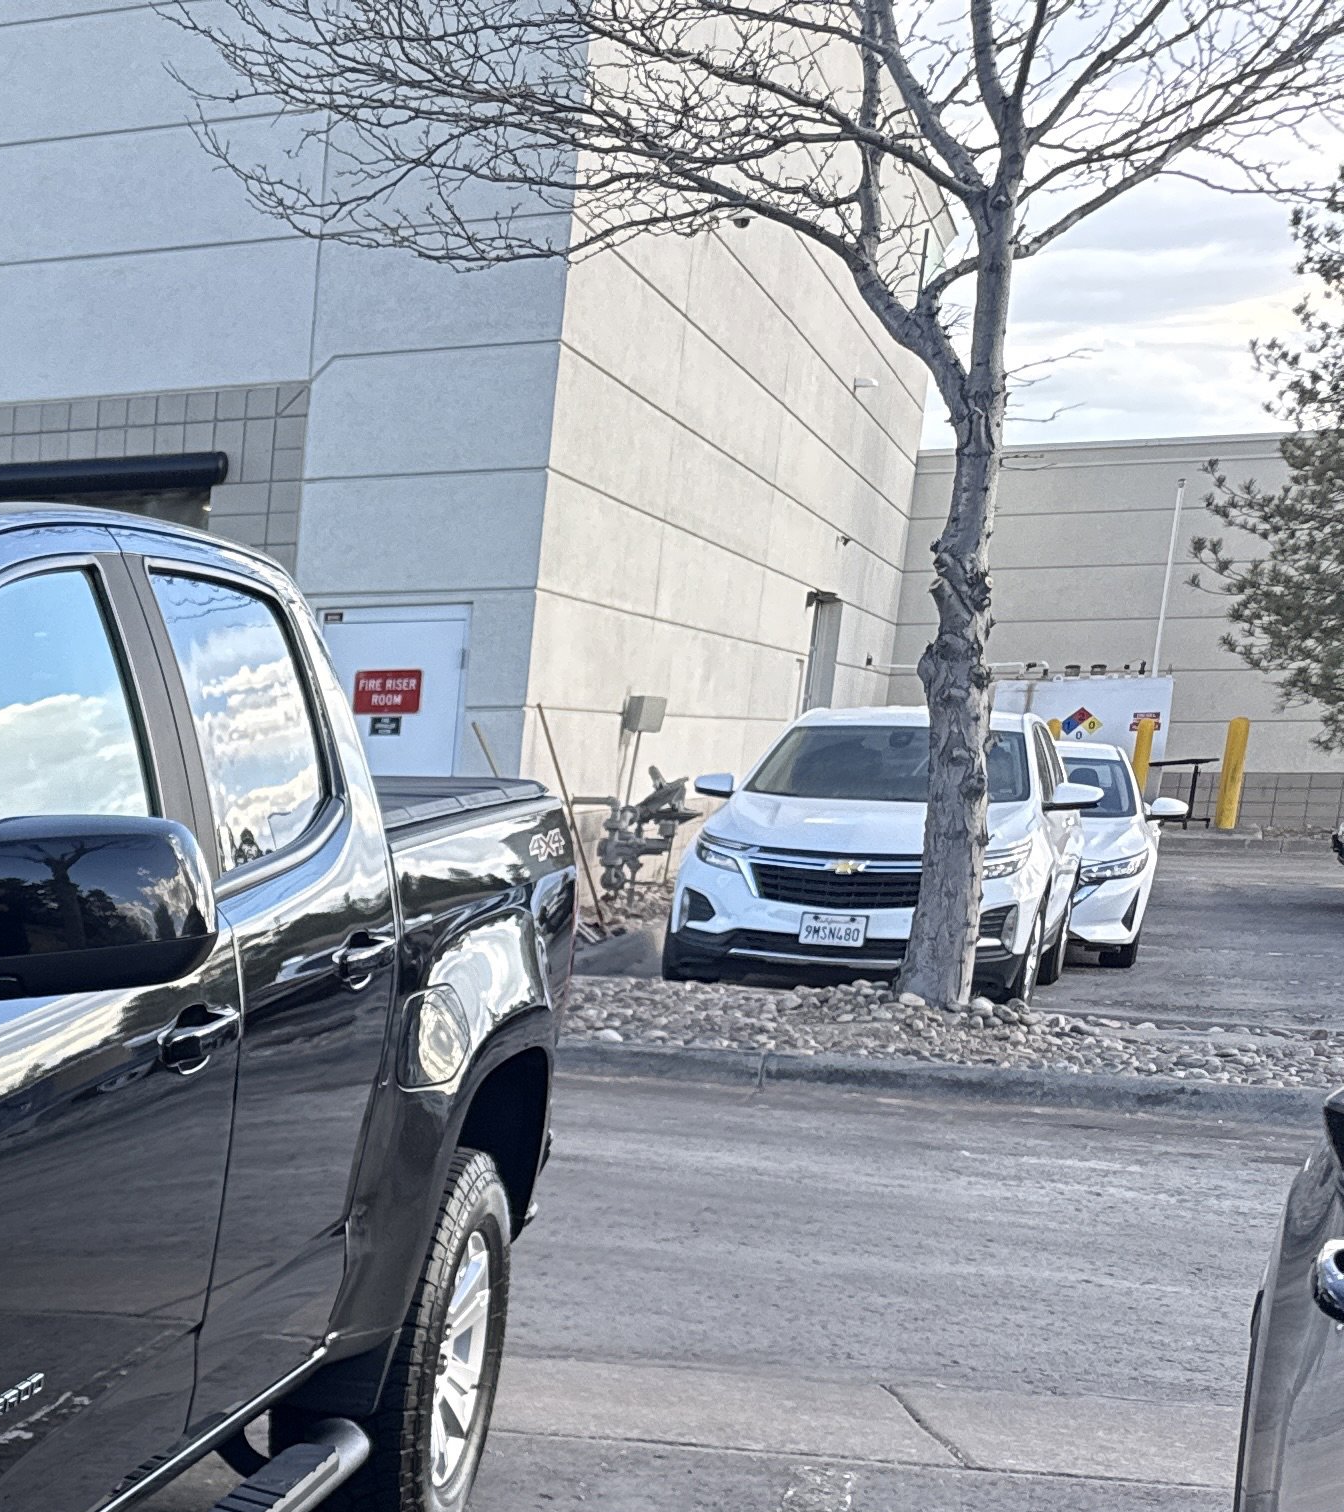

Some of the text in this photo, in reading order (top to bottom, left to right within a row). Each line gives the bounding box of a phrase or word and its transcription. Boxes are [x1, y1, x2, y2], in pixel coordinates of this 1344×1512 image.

[358, 679, 417, 691] FIRE RISER
[371, 694, 402, 705] ROOM
[1078, 712, 1086, 721] 2
[1088, 720, 1096, 730] 0
[1075, 731, 1083, 740] 0
[804, 925, 860, 942] 9MSN480
